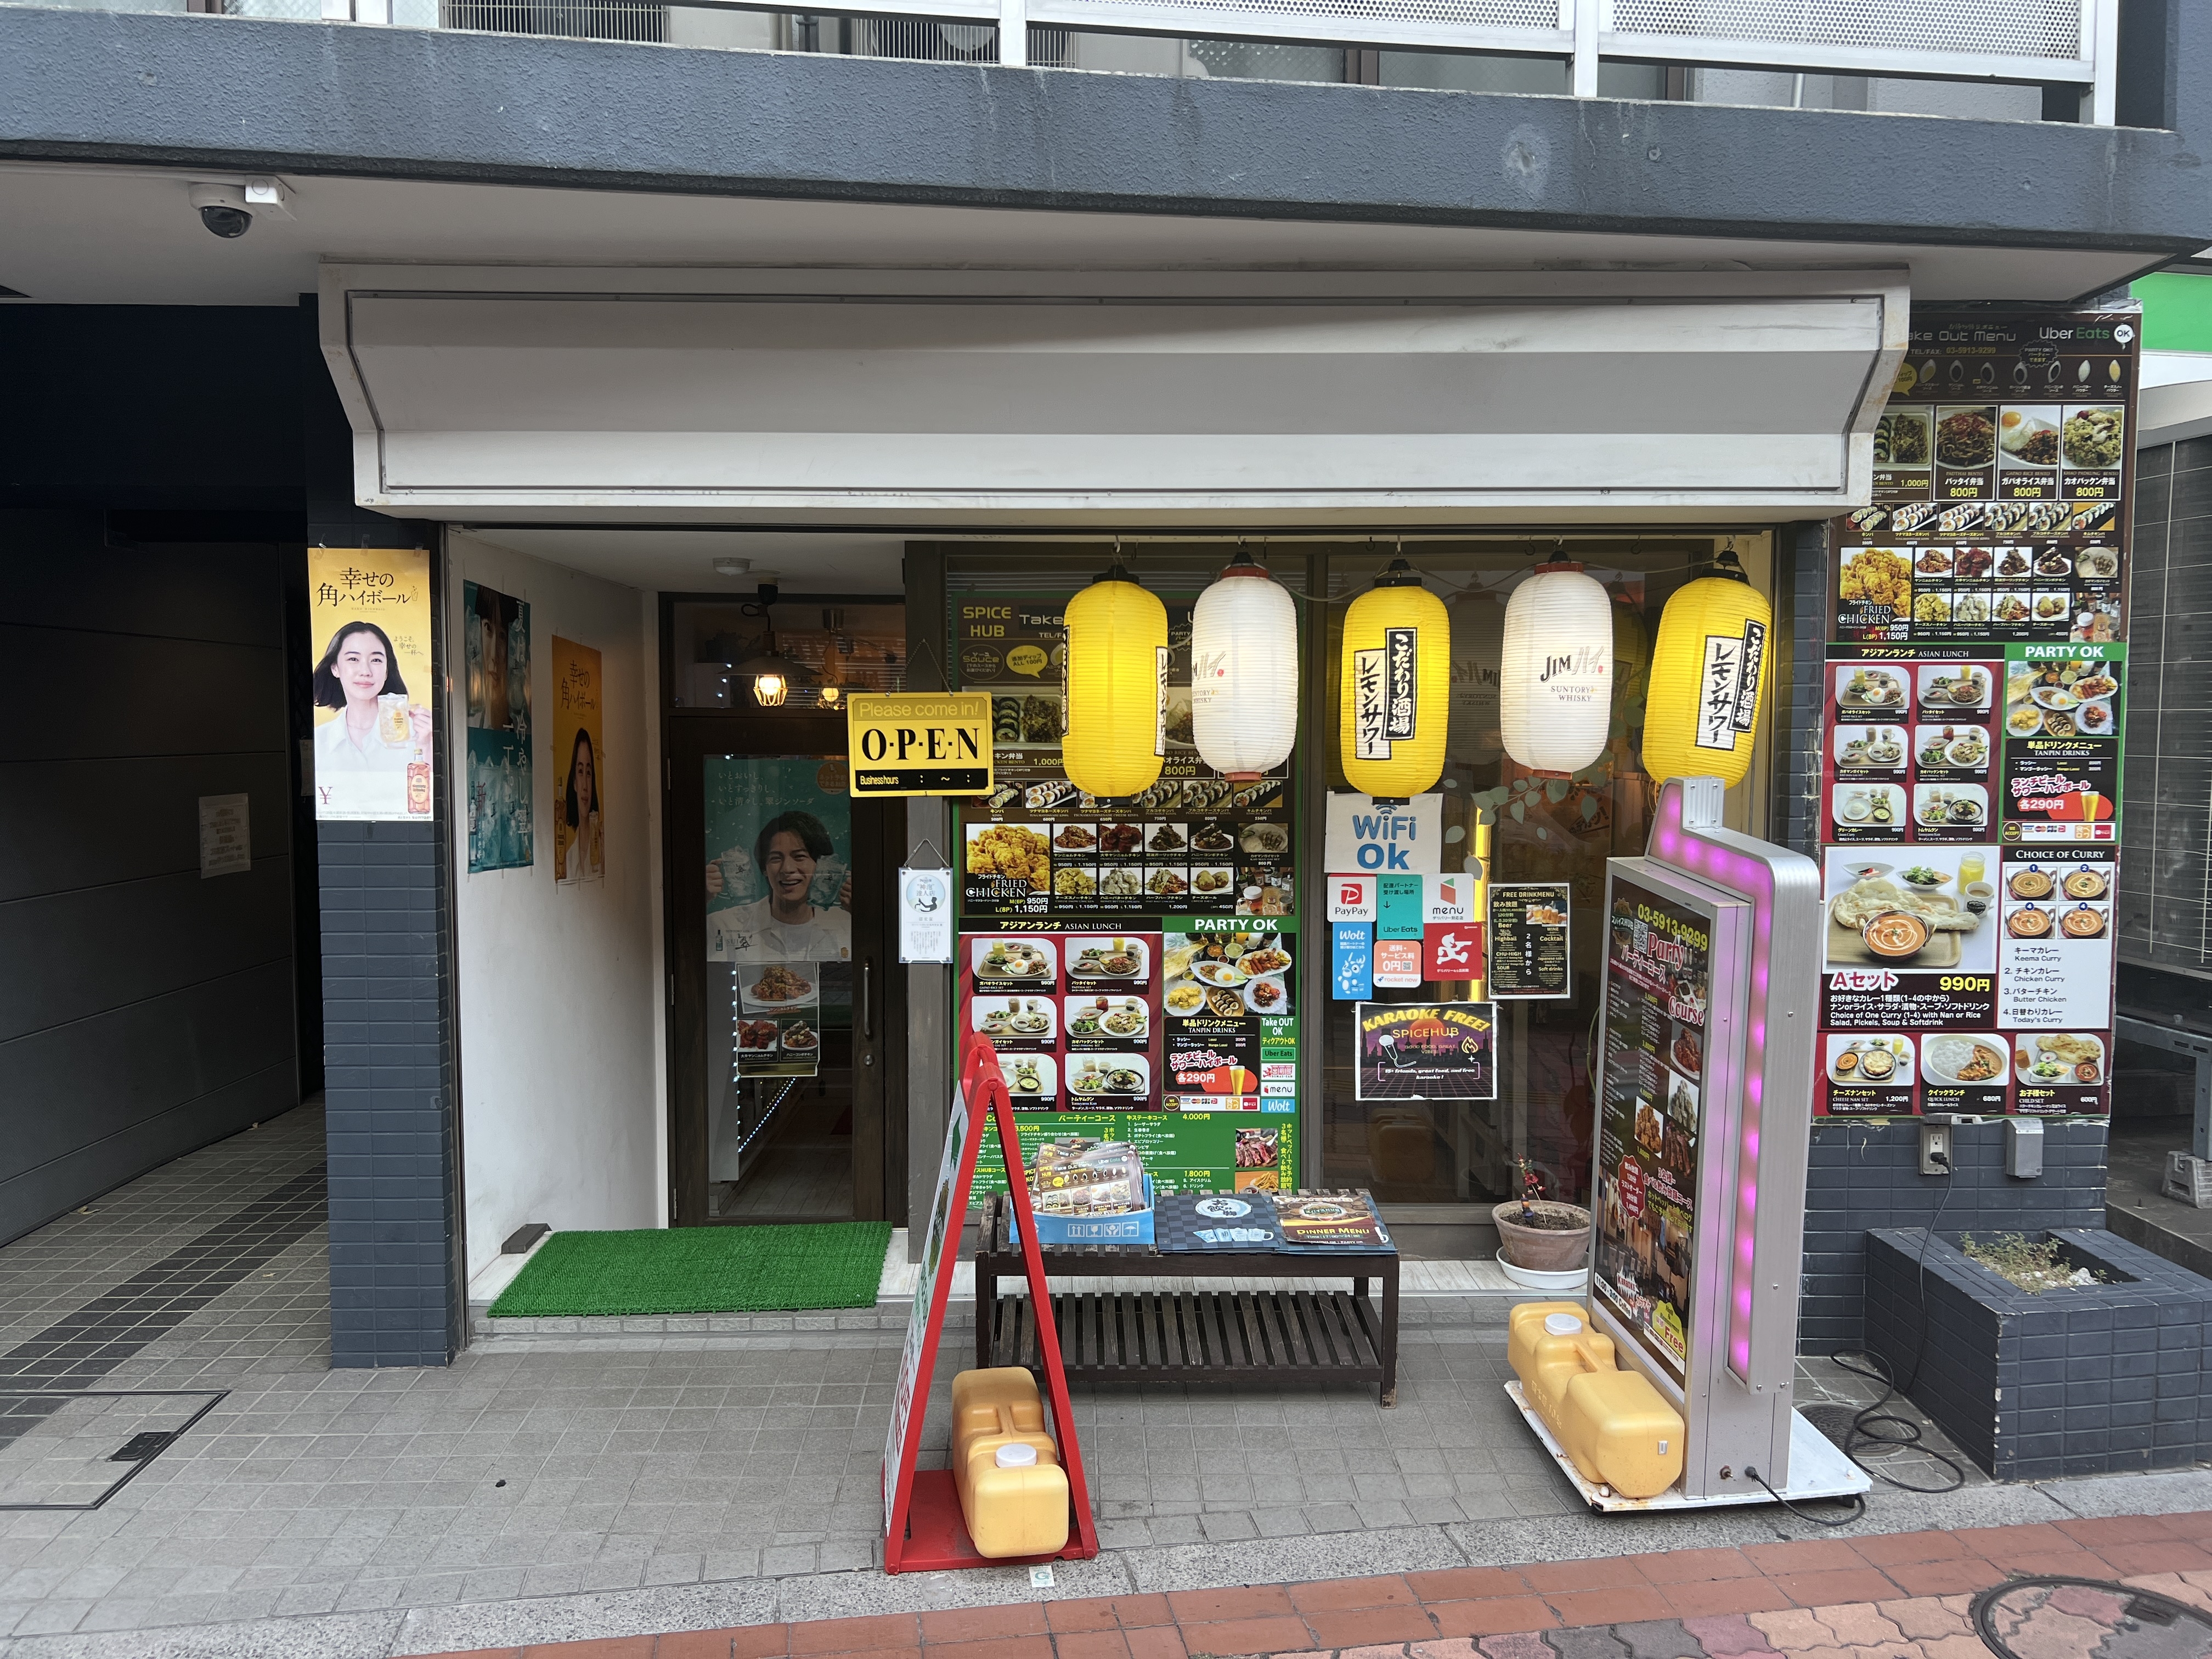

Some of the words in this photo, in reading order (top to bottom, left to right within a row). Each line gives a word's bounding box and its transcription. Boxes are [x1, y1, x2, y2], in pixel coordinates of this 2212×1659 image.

[1939, 331, 1968, 341] Out
[1974, 331, 2016, 341] Menu
[2039, 327, 2074, 340] Uber
[2076, 327, 2111, 340] Eats
[2117, 329, 2130, 337] OK
[1900, 479, 1929, 488] 1,000円
[1945, 477, 1984, 486] パッタイ弁当
[2001, 477, 2055, 487] ガパオライス弁当
[1949, 488, 1978, 498] 800円
[2013, 488, 2041, 498] 800円
[2076, 487, 2104, 498] 800円
[339, 567, 394, 590] 幸せの
[316, 582, 411, 607] 角ハイボール
[963, 606, 1012, 619] SPICE
[1864, 605, 1891, 614] FRIED
[1019, 614, 1063, 625] Take
[1838, 614, 1890, 624] CHICKEN
[970, 624, 1005, 637] HUB
[1879, 632, 1908, 641] 1,150円
[1860, 648, 1916, 657] アジアンランチ
[2025, 646, 2077, 658] PARTY
[2080, 646, 2104, 658] OK
[569, 659, 591, 690] 幸せの
[1735, 627, 1762, 727] こだわり酒場
[1390, 633, 1413, 735] こだわり酒場
[560, 676, 597, 710] 角ハイボール
[1707, 642, 1735, 743] レモンサワー
[860, 702, 912, 717] Please
[915, 706, 957, 716] come
[961, 701, 979, 716] in!
[1361, 656, 1382, 755] レモンサワー
[2027, 741, 2102, 749] 単品ドリンクメニュー
[1164, 766, 1196, 775] 800円
[2012, 774, 2066, 788] ランチビール
[2011, 780, 2091, 797] サワー・ハイボール
[2019, 799, 2064, 810] 各290円
[1352, 815, 1417, 840] WiFi
[1357, 843, 1410, 870] Ok
[2016, 850, 2055, 859] CHOICE
[2056, 850, 2069, 859] OF
[2072, 850, 2105, 859] CURRY
[995, 879, 1027, 888] FRIED
[966, 888, 1026, 898] CHICKEN
[1014, 905, 1048, 913] 1,150円
[1335, 907, 1369, 916] PayPay
[1000, 921, 1062, 930] アジアンランチ
[1195, 918, 1250, 930] PARTY
[1252, 918, 1278, 930] OK
[1638, 904, 1708, 951] 03-5913-9299
[1339, 930, 1365, 940] Wolt
[1647, 932, 1685, 971] Party
[1383, 961, 1400, 972] 0円
[1621, 944, 1666, 984] パーティーコース
[1939, 976, 1990, 992] 990円
[1668, 996, 1705, 1026] Course
[1262, 1018, 1278, 1026] Take
[1279, 1018, 1294, 1026] OUT
[1362, 1008, 1441, 1032] KARAOKE
[1443, 1009, 1492, 1032] FREE!
[1272, 1027, 1283, 1035] OK
[1392, 1027, 1459, 1039] SPICEHUB
[1170, 1049, 1216, 1062] ランチビール
[1170, 1055, 1238, 1071] サワー・ハイボール
[1177, 1073, 1215, 1083] 各290円
[1268, 1100, 1290, 1111] Wolt
[1664, 1325, 1684, 1353] Free
